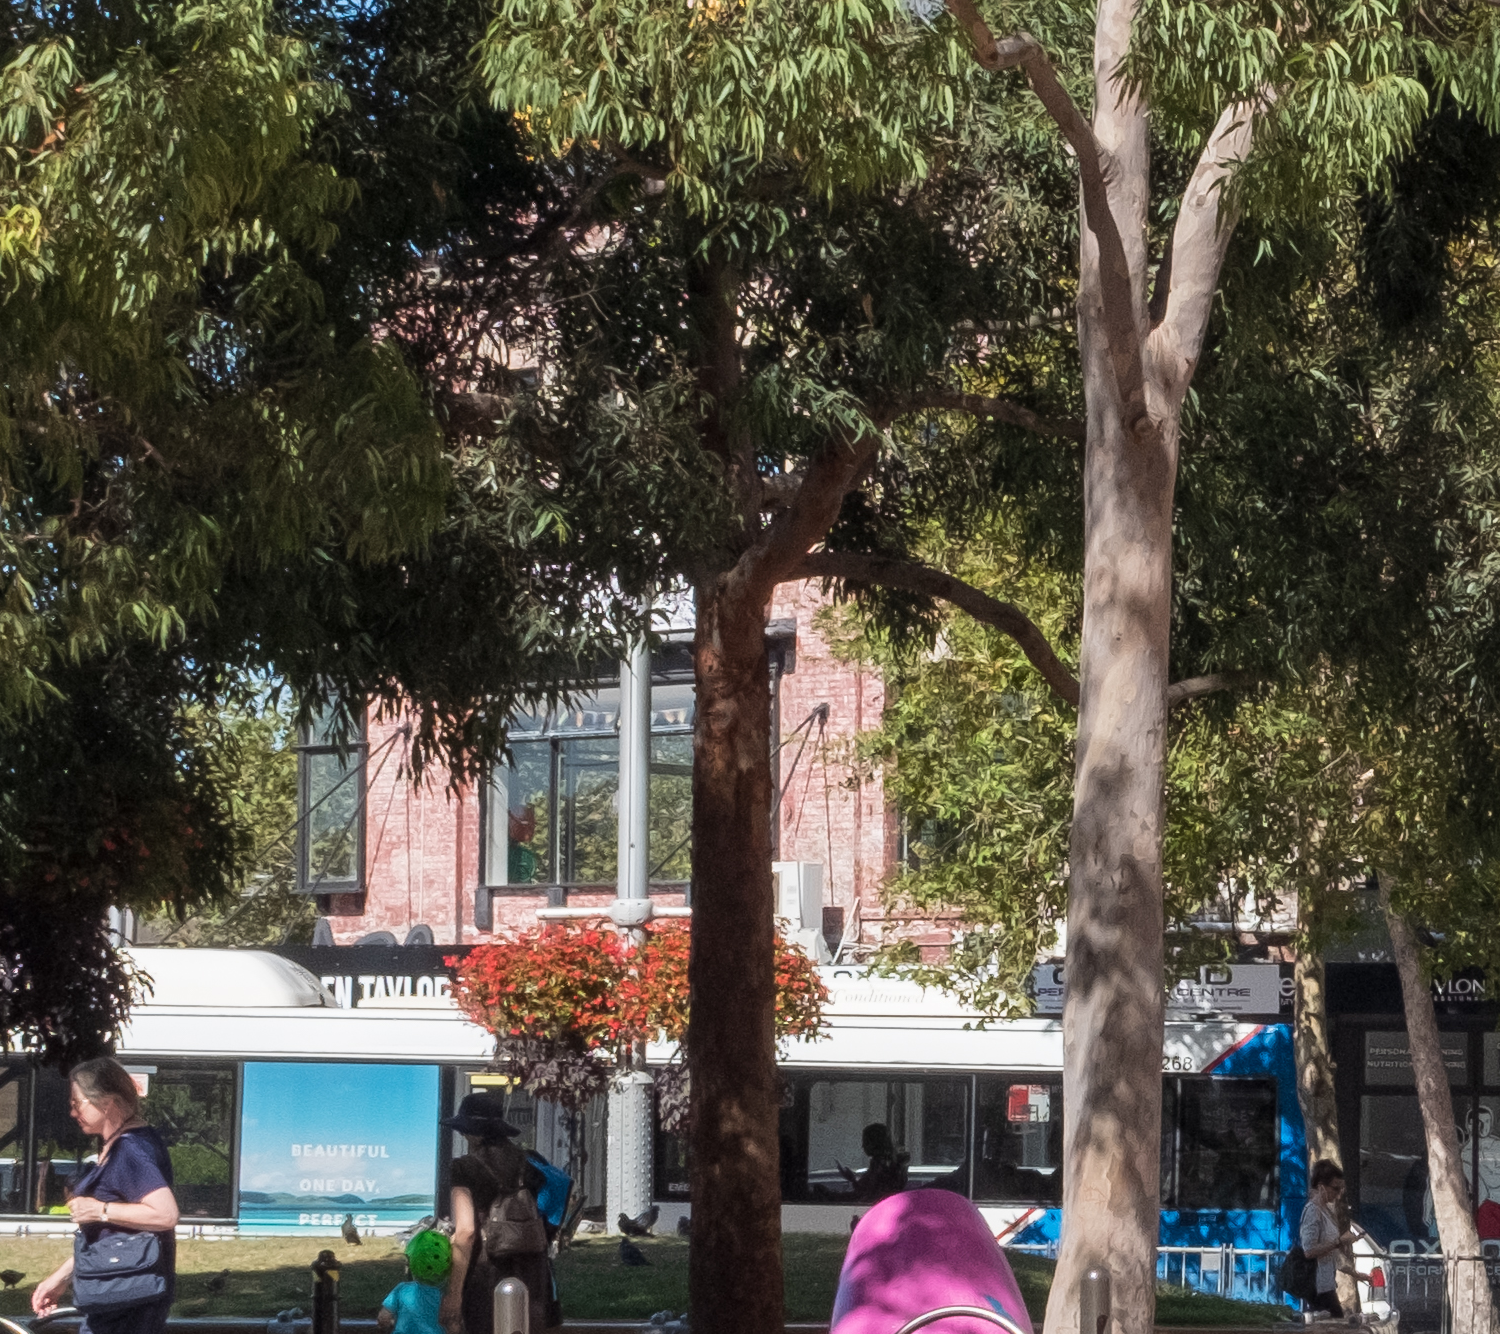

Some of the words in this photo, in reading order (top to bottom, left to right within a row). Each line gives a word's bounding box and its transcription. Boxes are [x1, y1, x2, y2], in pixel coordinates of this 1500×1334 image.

[832, 988, 926, 1004] Conditioned
[291, 1143, 390, 1159] BEAUTIFUL
[299, 1178, 336, 1193] ONE
[298, 1213, 379, 1227] PERFCT
